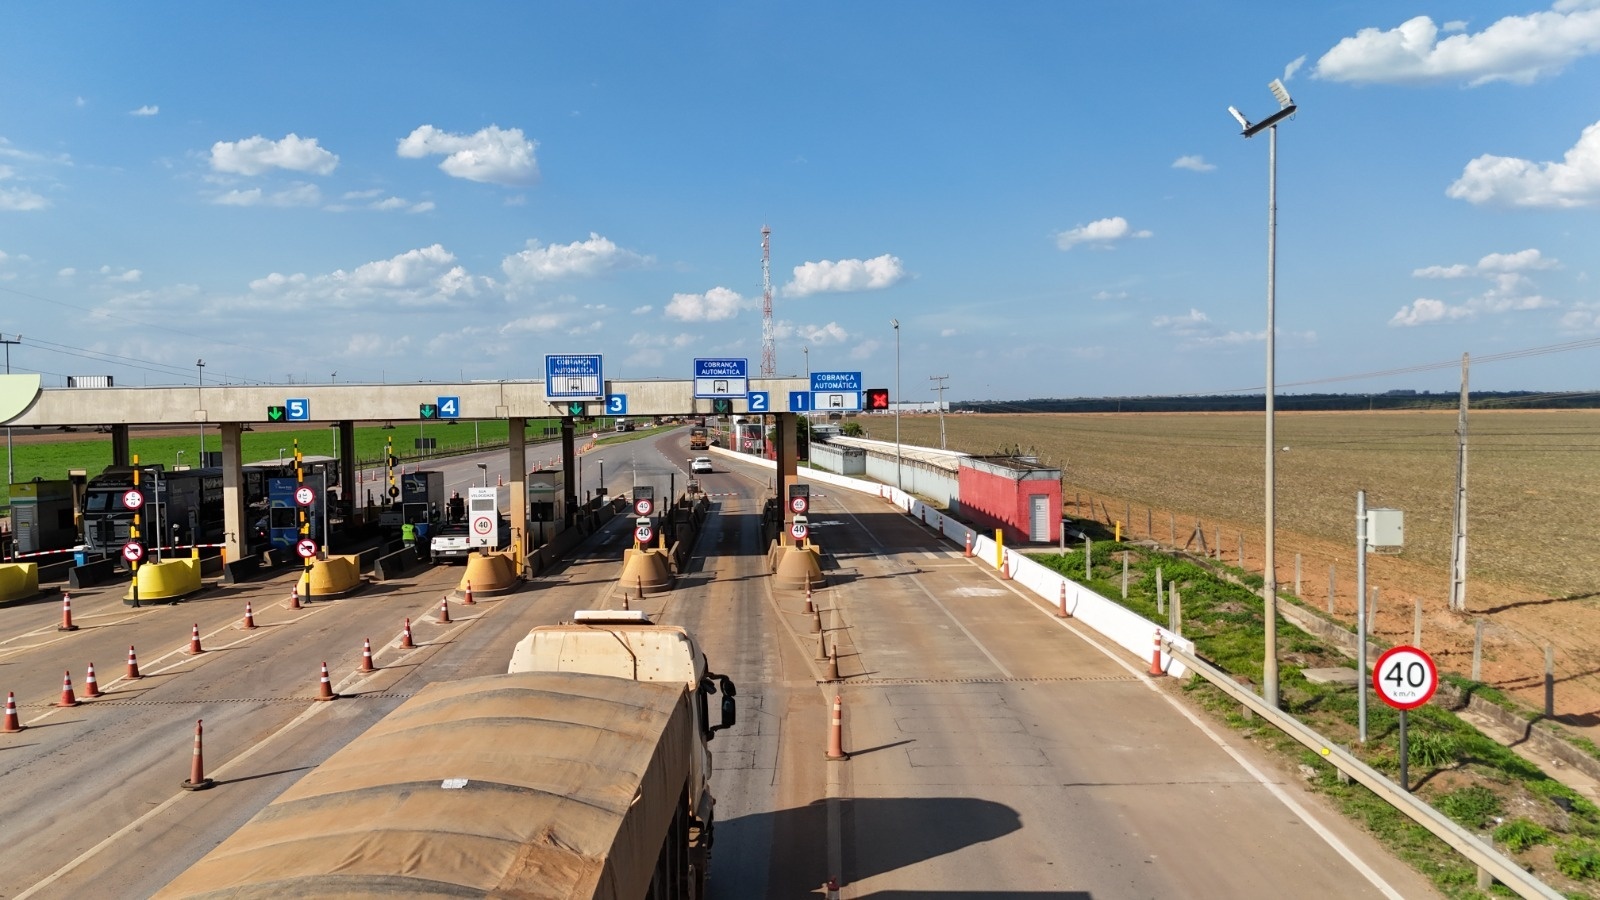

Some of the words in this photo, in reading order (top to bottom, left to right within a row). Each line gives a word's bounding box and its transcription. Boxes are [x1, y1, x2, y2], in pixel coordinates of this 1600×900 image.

[814, 381, 858, 389] AUTOMÁTICA
[817, 374, 855, 382] COBRANÇA
[291, 401, 304, 417] 5
[441, 399, 456, 415] 4
[610, 397, 623, 412] 3
[752, 394, 765, 409] 2
[796, 394, 802, 409] 1
[638, 528, 649, 536] 40
[794, 525, 804, 533] 40
[1384, 661, 1425, 688] 40
